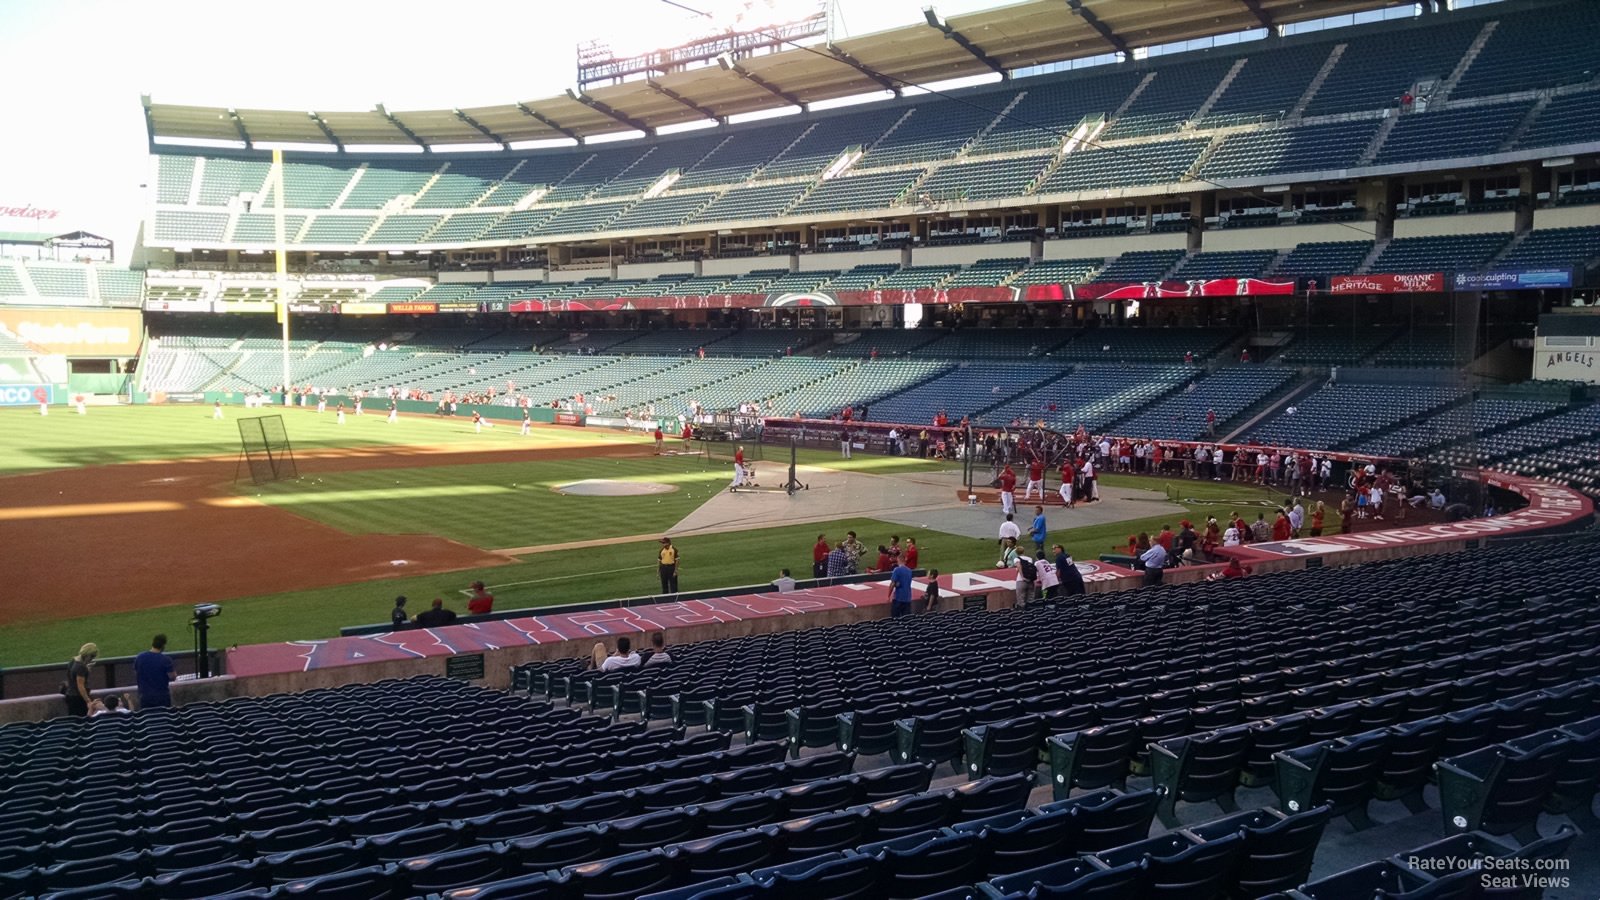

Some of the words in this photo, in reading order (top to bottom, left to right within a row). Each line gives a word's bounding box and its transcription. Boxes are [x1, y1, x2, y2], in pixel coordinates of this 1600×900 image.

[1393, 273, 1435, 283] ORGANIC
[1466, 272, 1517, 283] coolsculpting
[1331, 282, 1383, 292] HERITAGE
[1403, 280, 1428, 288] MILK
[1547, 351, 1594, 368] ANGELS
[734, 416, 765, 426] NETWO
[1540, 497, 1582, 510] THE
[1516, 508, 1573, 520] TO
[1352, 516, 1547, 545] WELCOME
